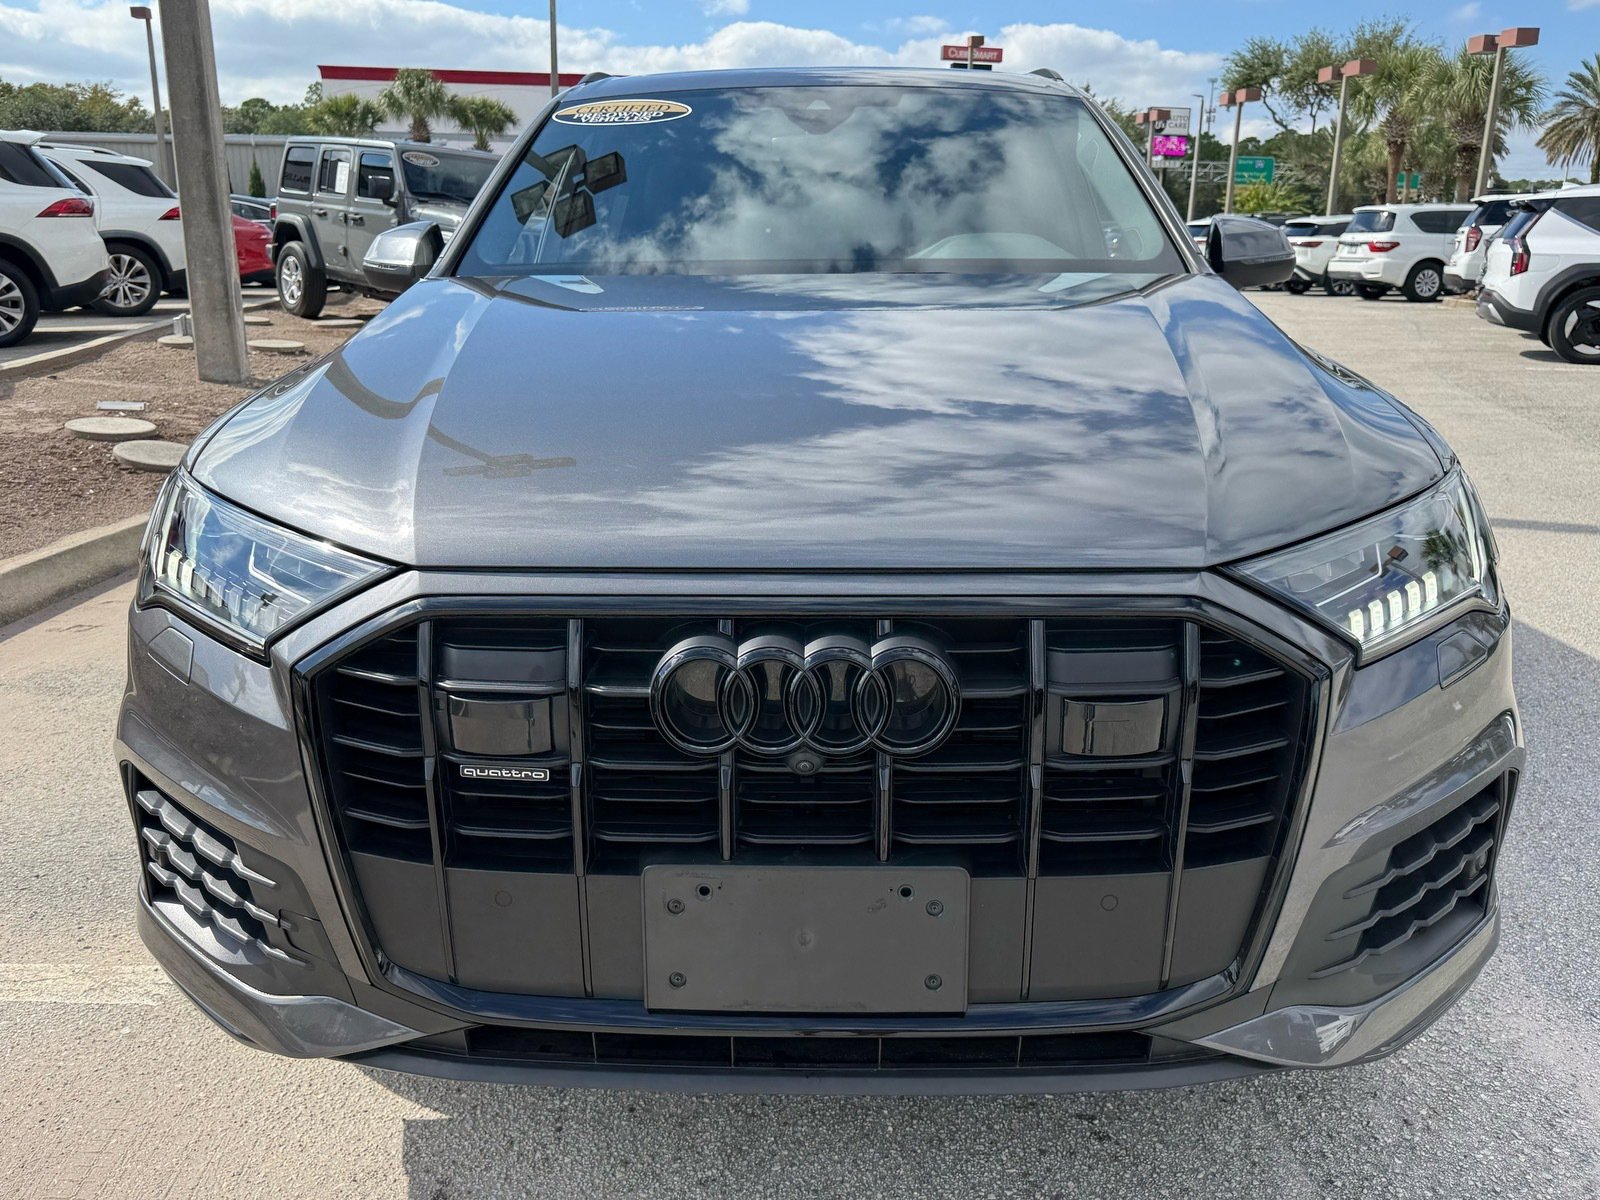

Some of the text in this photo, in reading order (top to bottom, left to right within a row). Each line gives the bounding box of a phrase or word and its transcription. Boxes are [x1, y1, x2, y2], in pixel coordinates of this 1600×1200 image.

[576, 104, 671, 113] CERTIFIED
[573, 111, 664, 119] PRE-OWNED
[1168, 121, 1187, 129] CARE
[464, 768, 545, 779] quattro
